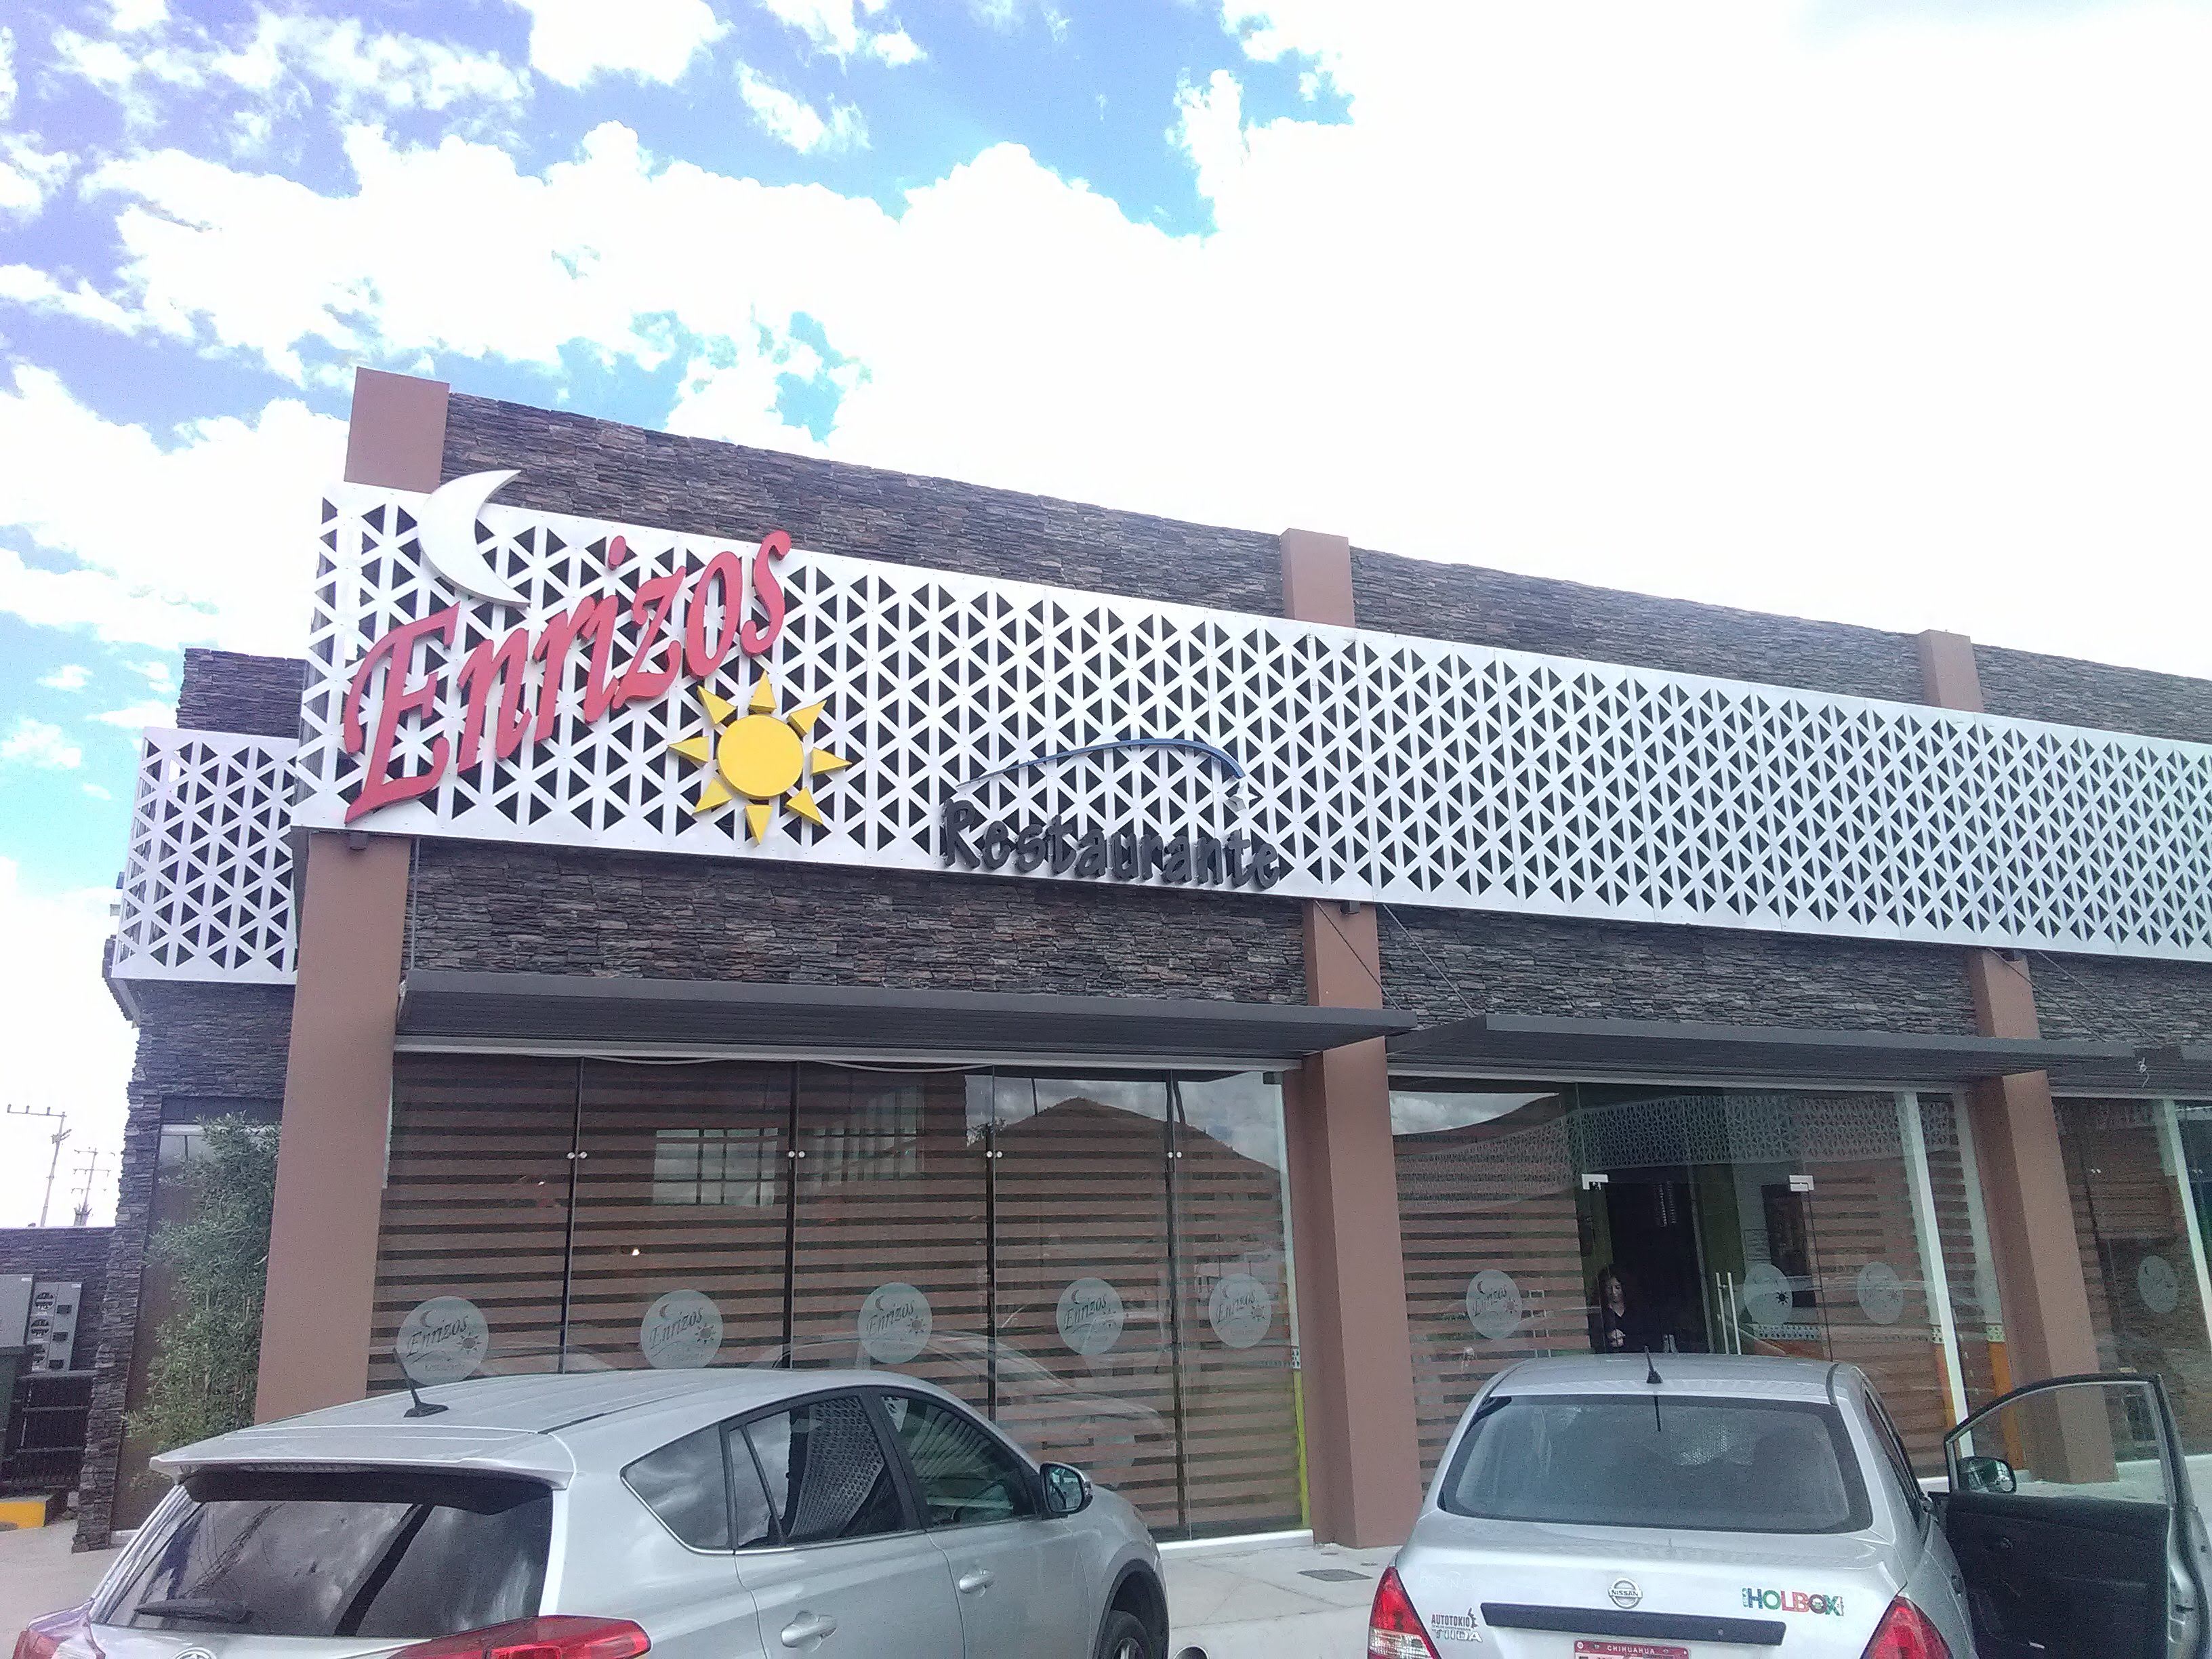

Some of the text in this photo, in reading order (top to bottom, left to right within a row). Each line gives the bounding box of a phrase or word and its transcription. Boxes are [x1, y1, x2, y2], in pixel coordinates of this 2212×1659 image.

[942, 798, 1280, 889] Restaurante
[1747, 1588, 1843, 1616] HOLBOX
[1431, 1614, 1470, 1627] AUTOTOKIO
[1435, 1629, 1483, 1643] TIIDA
[1607, 1645, 1655, 1654] CHIHUAHUA
